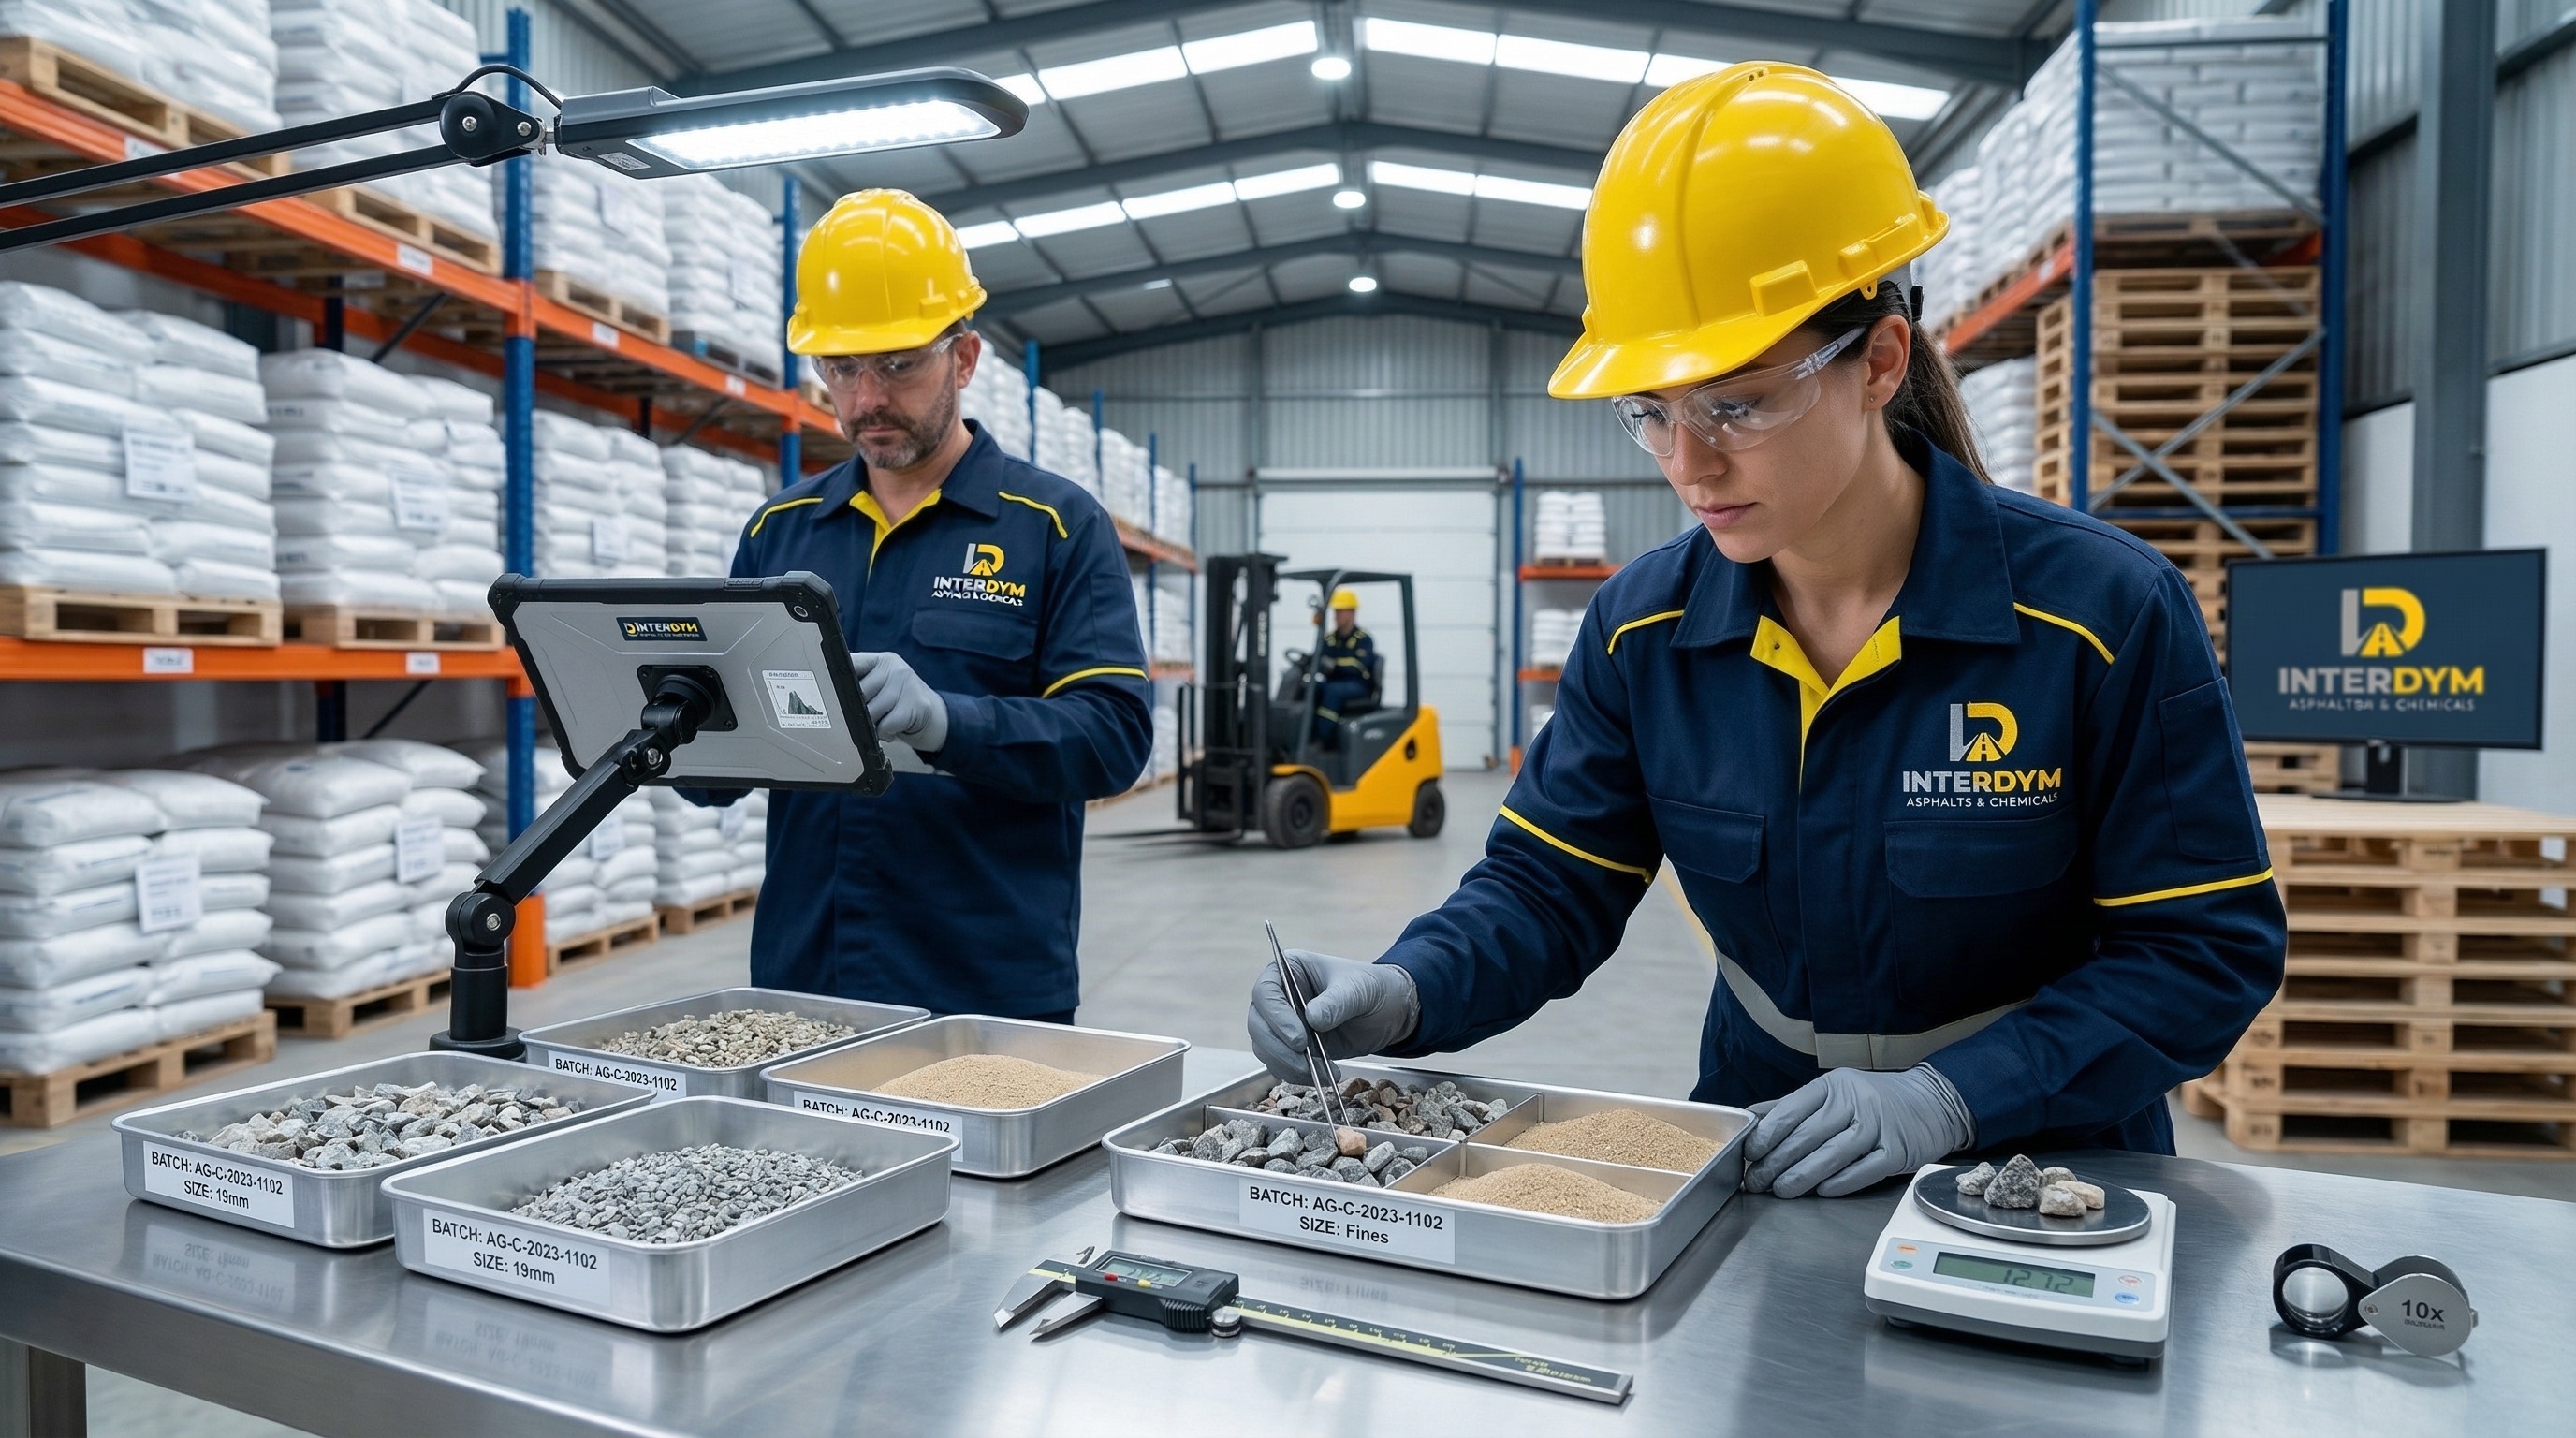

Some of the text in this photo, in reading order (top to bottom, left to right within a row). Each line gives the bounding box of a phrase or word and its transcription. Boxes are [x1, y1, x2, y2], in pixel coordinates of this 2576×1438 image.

[933, 576, 1026, 597] INTERDYM
[2278, 666, 2484, 695] INTERDYM
[2394, 698, 2475, 712] CHEMICALS
[1902, 768, 2062, 793] INTERDYM
[1906, 792, 2058, 808] ASPHALTS & CHEMICALS
[555, 1058, 677, 1091] BATCH: AG-C-2023-1102
[803, 1099, 848, 1115] BATCH:
[152, 1151, 284, 1195] BATCH: AG-C-2023-1102
[184, 1180, 249, 1209] SIZE: 19mm
[1250, 1185, 1443, 1230] BATCH: AG-C-2023-1102
[432, 1218, 598, 1270] BATCH: AG-C-2023-1102
[1299, 1216, 1389, 1244] SIZE: Fines
[473, 1251, 555, 1284] SIZE: 19mm
[2401, 1299, 2445, 1323] 10x
